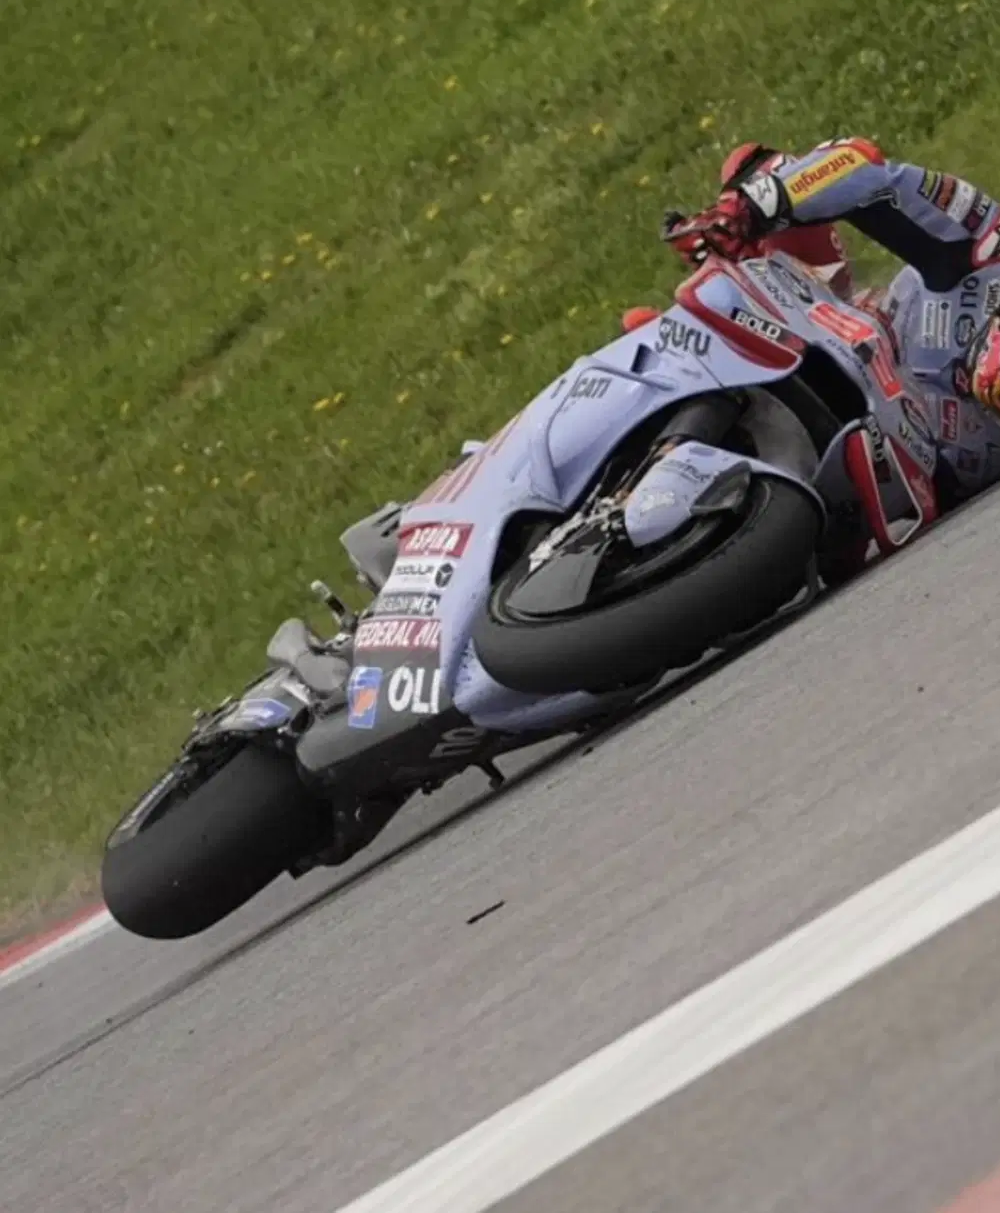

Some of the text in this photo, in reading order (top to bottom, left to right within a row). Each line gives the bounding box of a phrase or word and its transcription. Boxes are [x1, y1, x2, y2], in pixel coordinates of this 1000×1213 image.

[789, 152, 856, 195] Antangin
[960, 275, 980, 309] OLI
[655, 317, 712, 357] guru
[734, 309, 782, 341] BOLD
[387, 665, 440, 715] OLI
